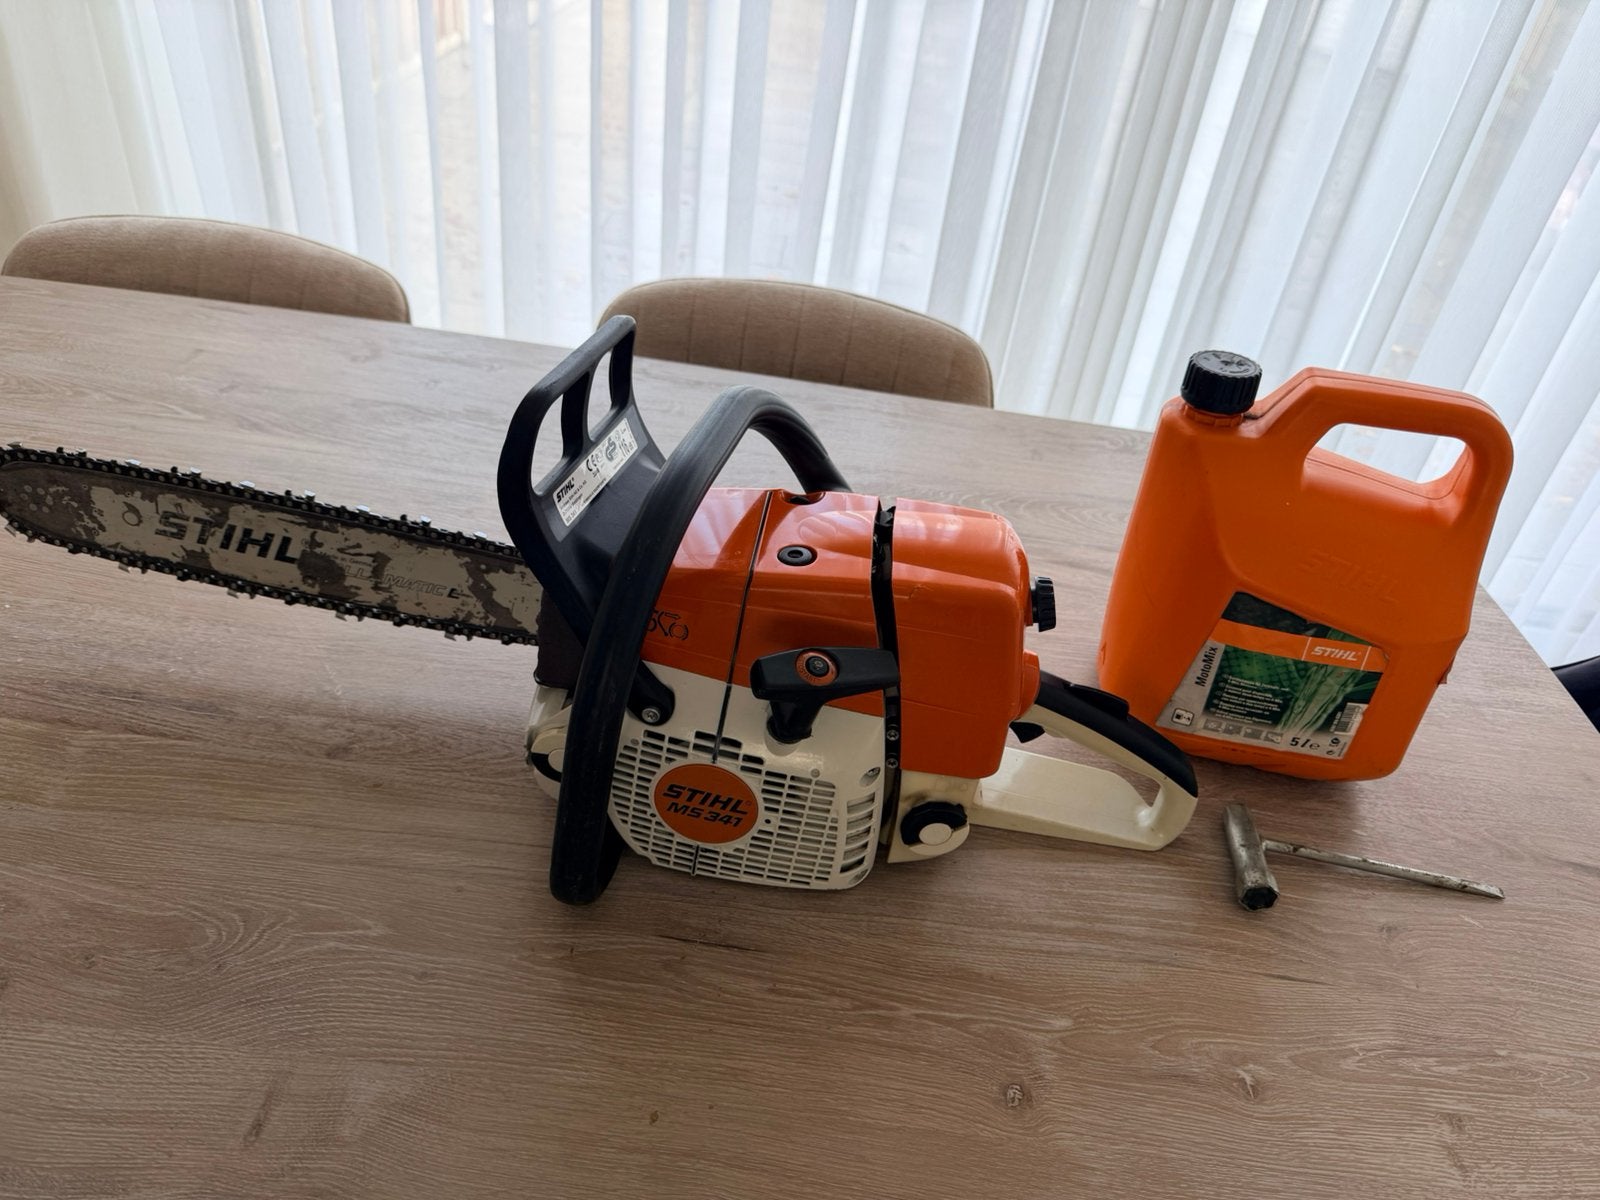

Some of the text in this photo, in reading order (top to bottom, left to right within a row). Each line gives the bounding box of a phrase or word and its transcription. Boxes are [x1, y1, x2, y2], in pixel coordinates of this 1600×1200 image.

[556, 481, 575, 503] STIHL
[155, 510, 299, 565] STIHL
[1195, 645, 1218, 688] MotoMix
[1310, 645, 1359, 662] STIHL
[662, 783, 748, 815] STIHL
[667, 802, 743, 828] MS 341
